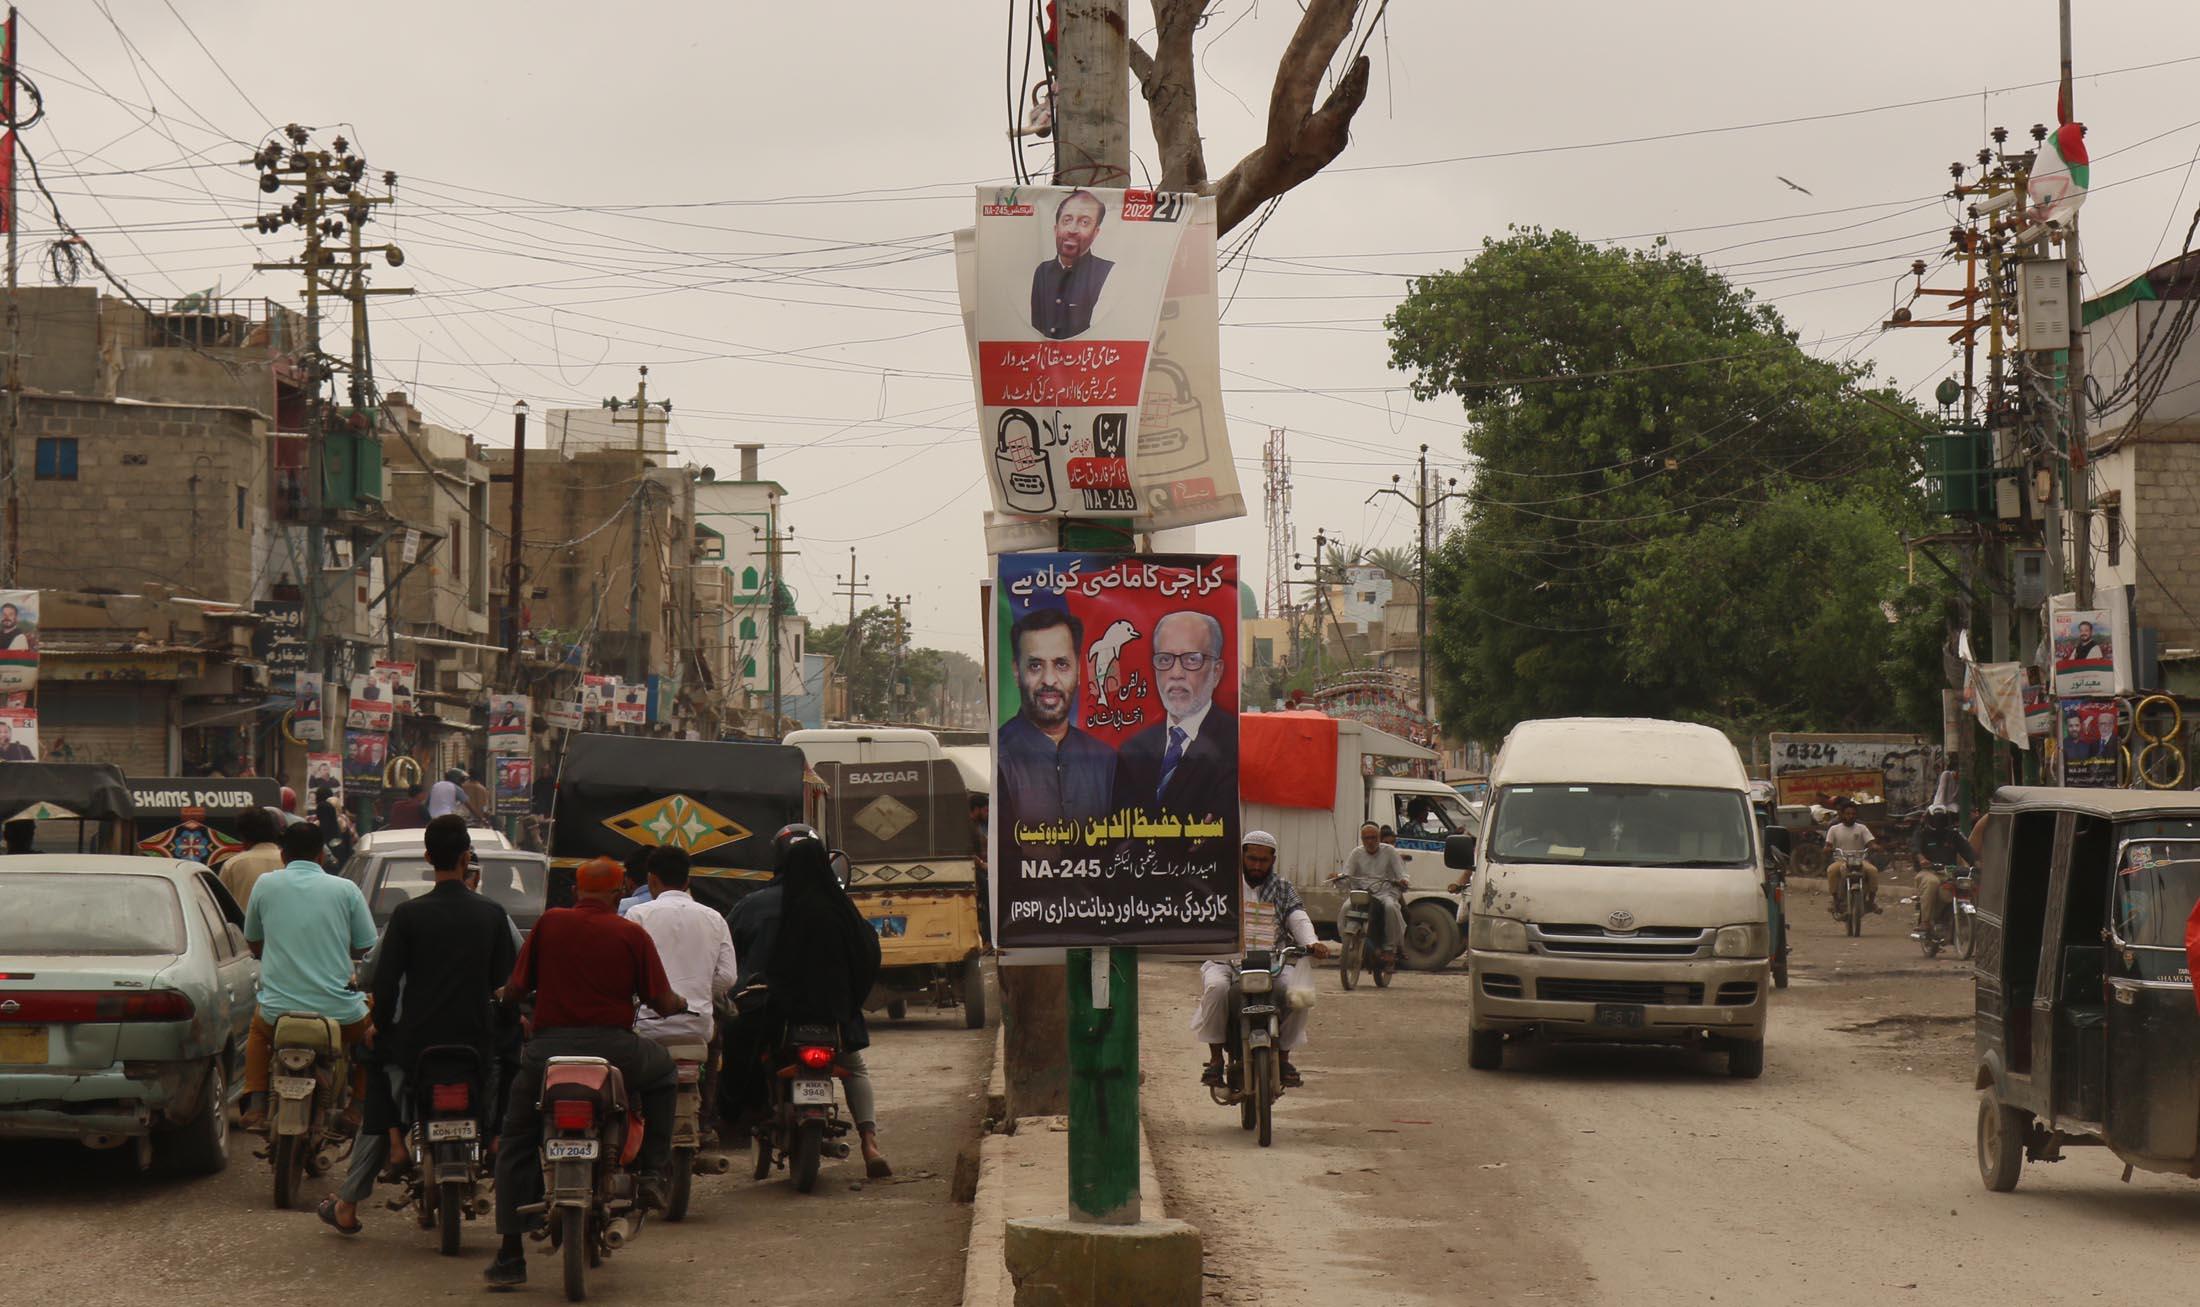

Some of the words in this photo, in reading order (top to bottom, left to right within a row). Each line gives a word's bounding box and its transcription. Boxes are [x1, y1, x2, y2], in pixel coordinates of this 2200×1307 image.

[984, 206, 1008, 216] NA-245
[1124, 203, 1153, 217] 2022
[1153, 192, 1181, 219] 21
[1063, 347, 1092, 371] قیادت
[1092, 346, 1121, 370] مقامی
[1042, 410, 1072, 446] تالا
[1099, 415, 1122, 459] اپنا
[1070, 466, 1088, 482] ستار
[1086, 462, 1109, 485] فاروق
[1084, 488, 1134, 509] NA-245
[1035, 560, 1082, 596] گواہ
[1082, 564, 1143, 596] ماضی
[1142, 564, 1161, 588] کا
[1159, 565, 1224, 599] کراچی
[1010, 571, 1034, 607] ہے
[1119, 671, 1147, 701] ڈولفن
[1087, 710, 1115, 728] نشان
[1113, 708, 1143, 731] انتخابی
[1786, 742, 1838, 764] 0324
[849, 770, 919, 784] SAZGAR
[133, 790, 192, 808] SHAMS
[194, 790, 254, 808] POWER
[1084, 807, 1131, 847] الدین
[1133, 807, 1183, 845] حفیظ
[1184, 813, 1224, 845] سید
[1021, 860, 1102, 879] NA-245
[1105, 850, 1133, 878] الیکشن
[1135, 849, 1157, 878] ضمنی
[1151, 860, 1179, 878] برائے
[1181, 861, 1217, 879] امیدوار
[1011, 901, 1042, 921] (PSP)
[1115, 896, 1135, 924] اور
[1136, 896, 1173, 924] تجربہ
[802, 1088, 825, 1097] 3948
[567, 1146, 592, 1156] 2043
